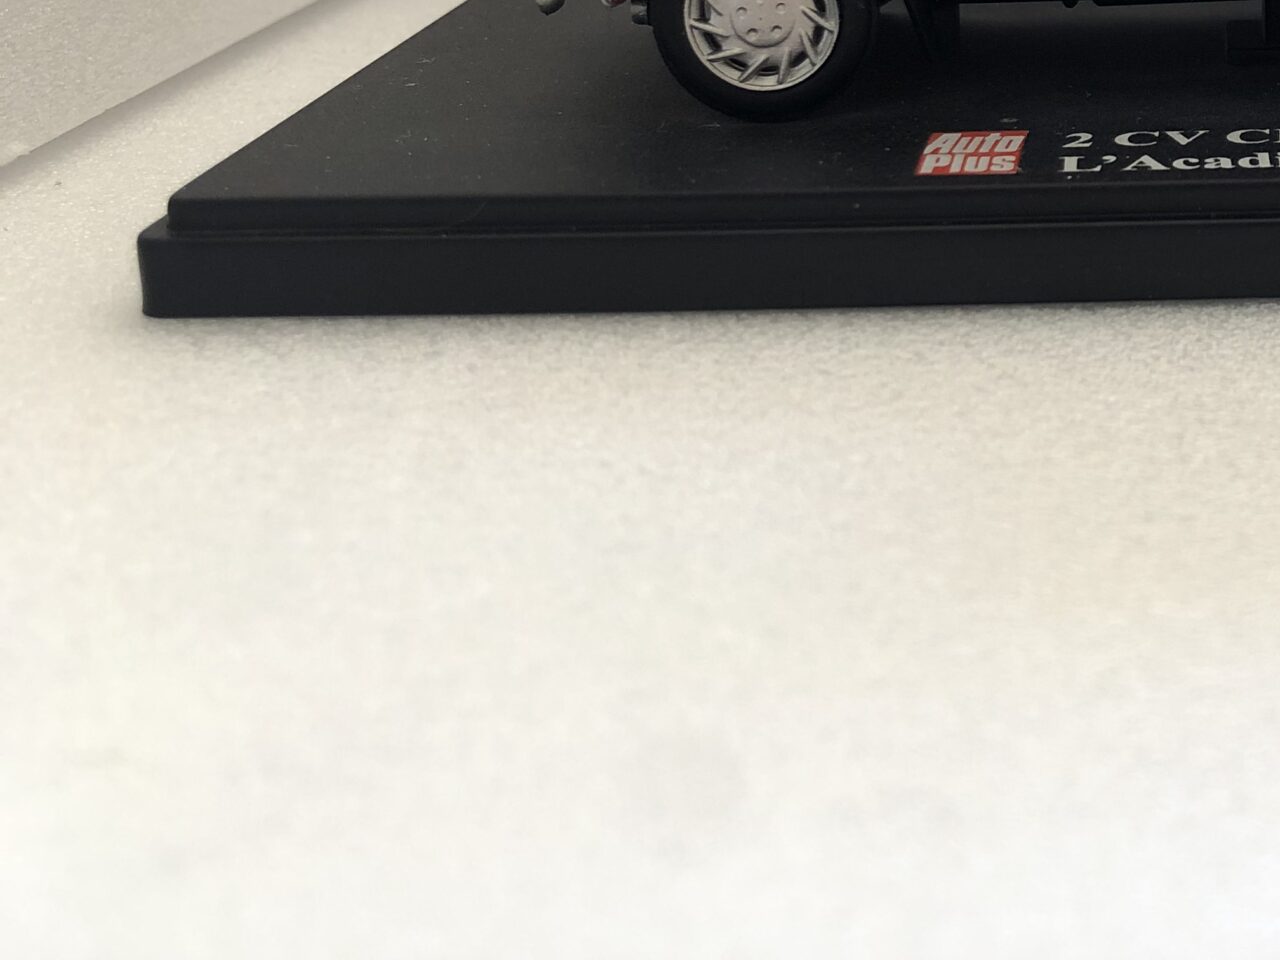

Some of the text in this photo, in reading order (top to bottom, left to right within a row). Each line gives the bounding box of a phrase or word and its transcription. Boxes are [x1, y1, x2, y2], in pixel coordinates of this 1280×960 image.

[926, 132, 1025, 154] Auto
[1061, 132, 1093, 148] 2
[1113, 129, 1209, 147] CV
[921, 153, 1016, 174] Plus
